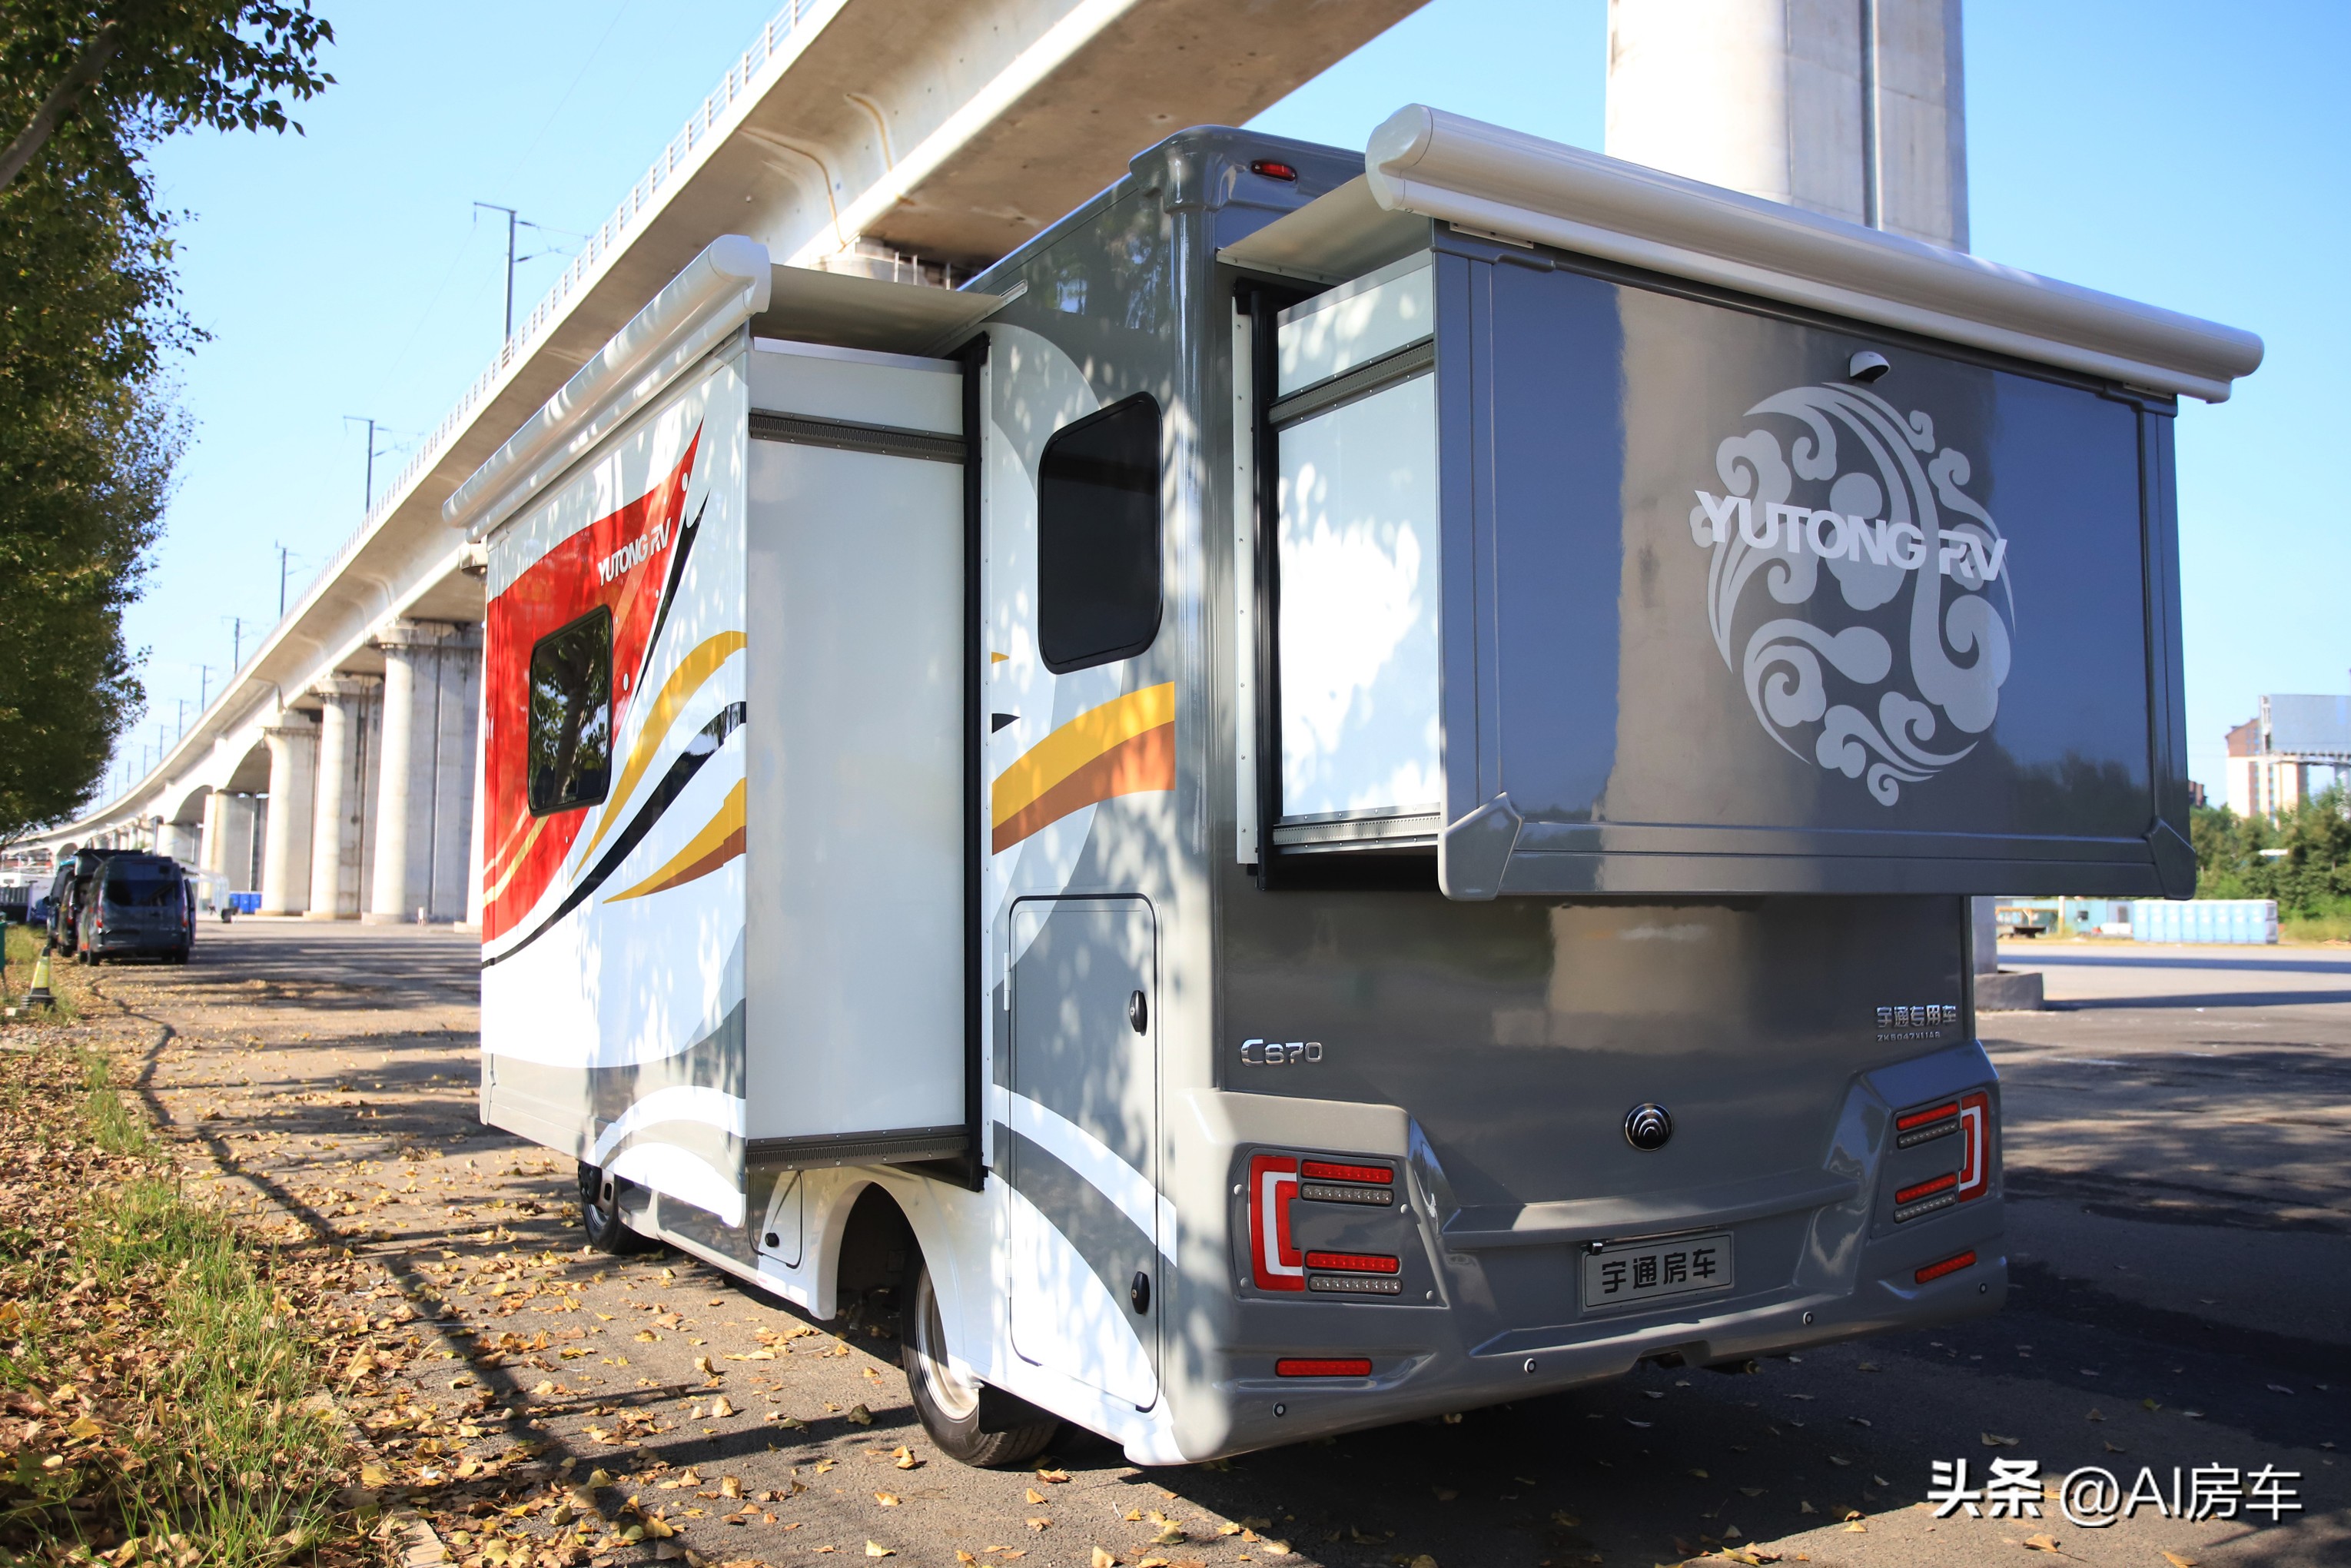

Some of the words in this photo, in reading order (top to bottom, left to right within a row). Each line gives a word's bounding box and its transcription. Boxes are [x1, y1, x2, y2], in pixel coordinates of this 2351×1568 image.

[597, 533, 648, 586] YUTONG
[650, 517, 672, 556] RV
[1695, 490, 1927, 570] YUTONG
[1938, 528, 2007, 582] RV
[1876, 1004, 1956, 1028] 宇通专用车
[1240, 1038, 1323, 1067] C670
[1602, 1248, 1715, 1294] 宇通房车
